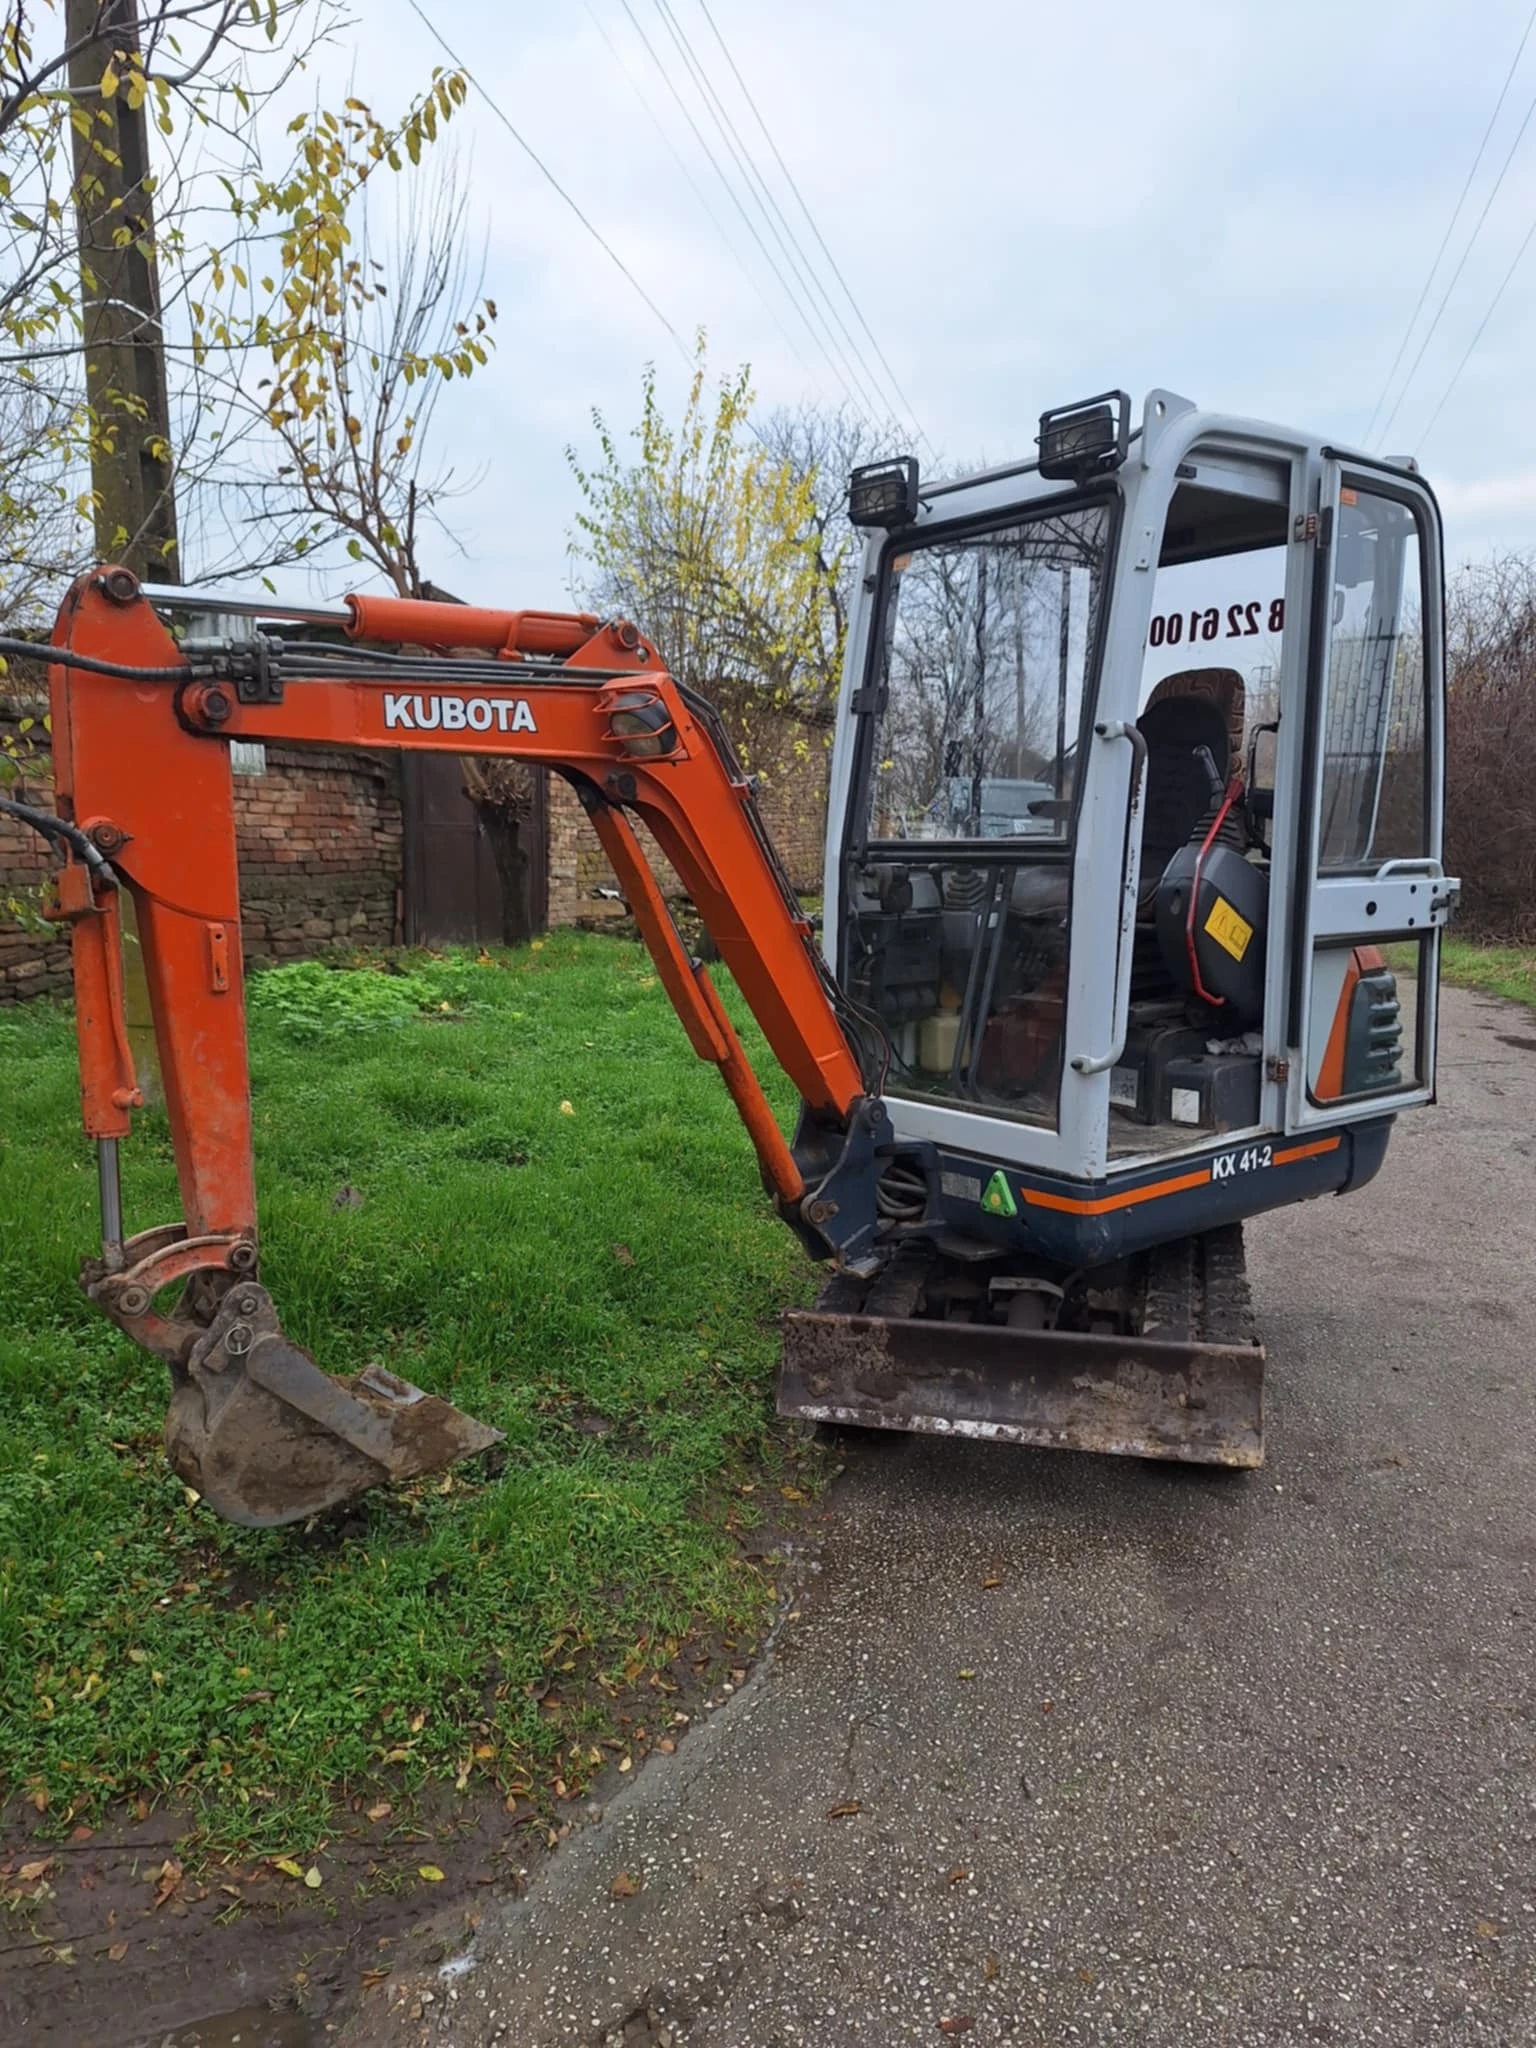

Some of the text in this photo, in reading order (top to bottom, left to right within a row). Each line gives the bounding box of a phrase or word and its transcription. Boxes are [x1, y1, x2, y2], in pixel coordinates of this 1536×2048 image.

[384, 693, 538, 732] KUBOTA
[1212, 1145, 1272, 1180] KX 41-2
